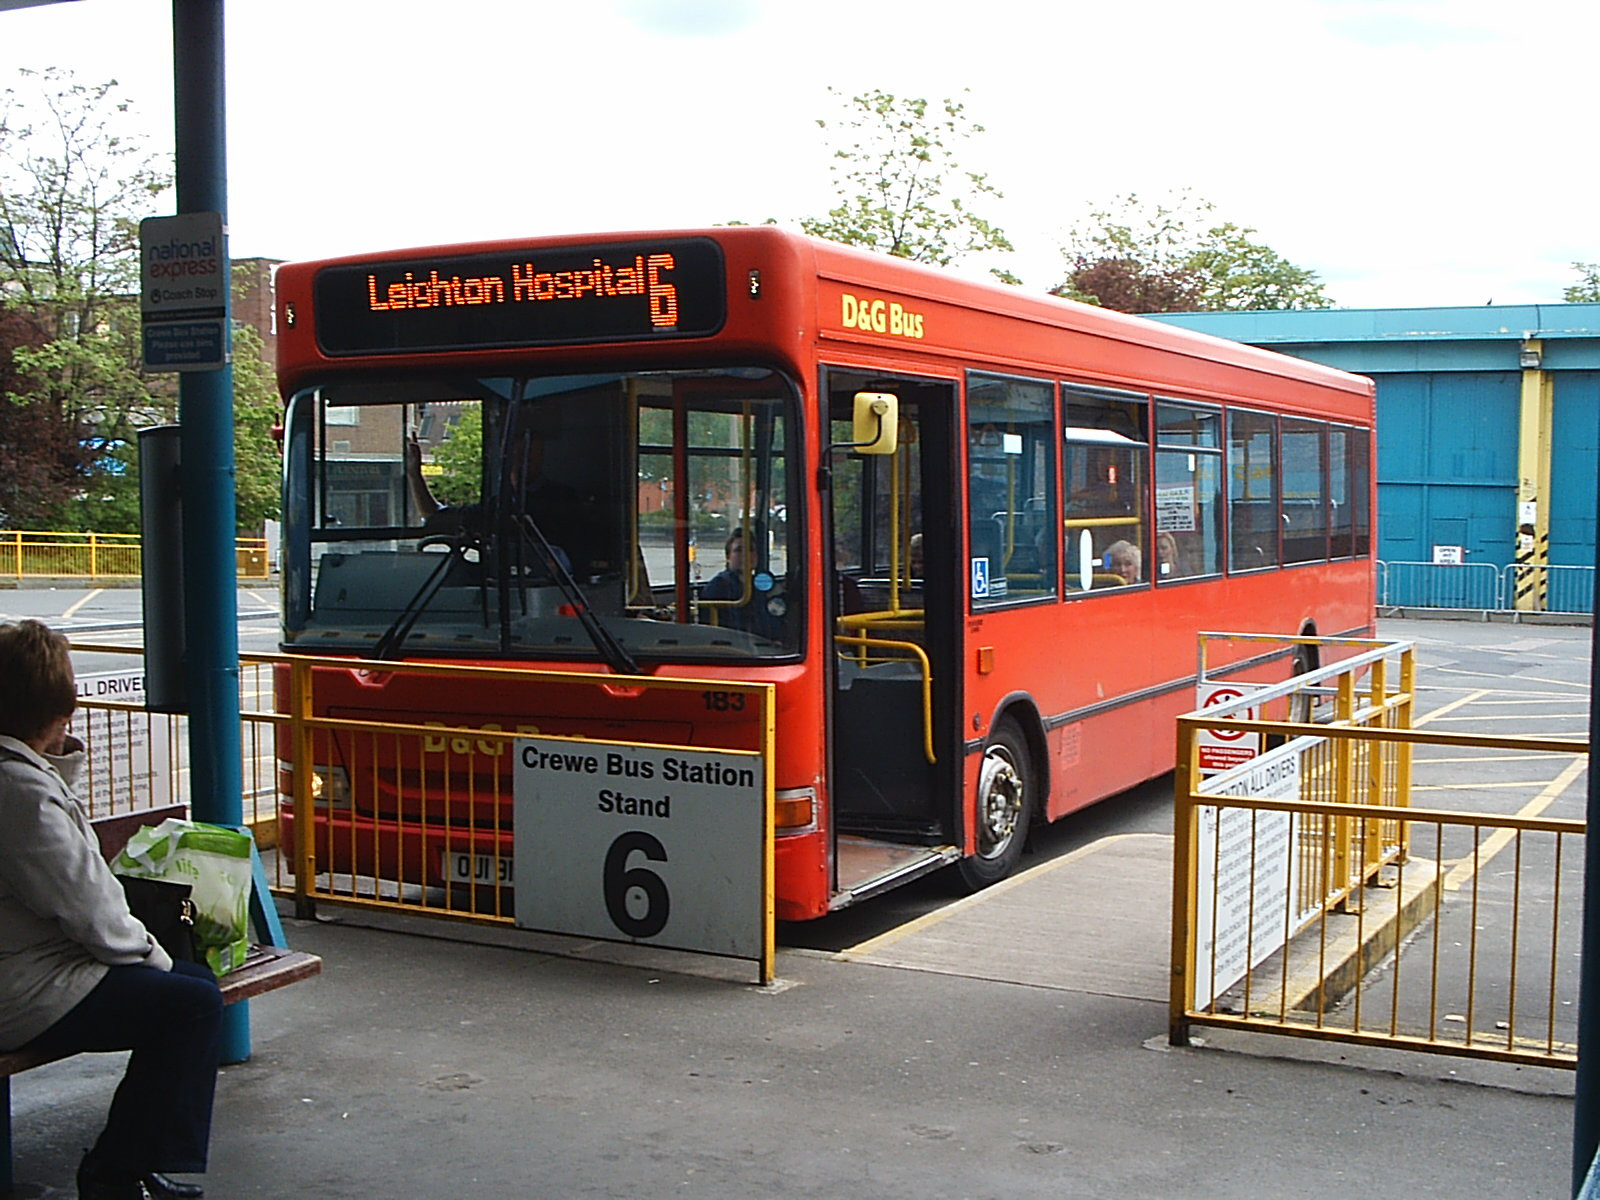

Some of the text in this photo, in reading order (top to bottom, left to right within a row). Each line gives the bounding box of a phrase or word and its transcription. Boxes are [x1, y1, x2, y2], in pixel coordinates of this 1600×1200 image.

[149, 235, 216, 260] national
[150, 259, 217, 282] express
[367, 255, 645, 311] Leighton Hospital
[163, 287, 217, 301] Coach Stop
[648, 253, 678, 328] 6
[842, 294, 924, 339] D&G Bus
[75, 676, 143, 698] LL DRIVE
[702, 690, 745, 711] 183
[521, 745, 754, 788] Crewe Bus Station
[1250, 769, 1264, 794] ALL
[1265, 755, 1296, 787] DRIVERS
[597, 789, 671, 818] Stand
[603, 830, 671, 939] 6
